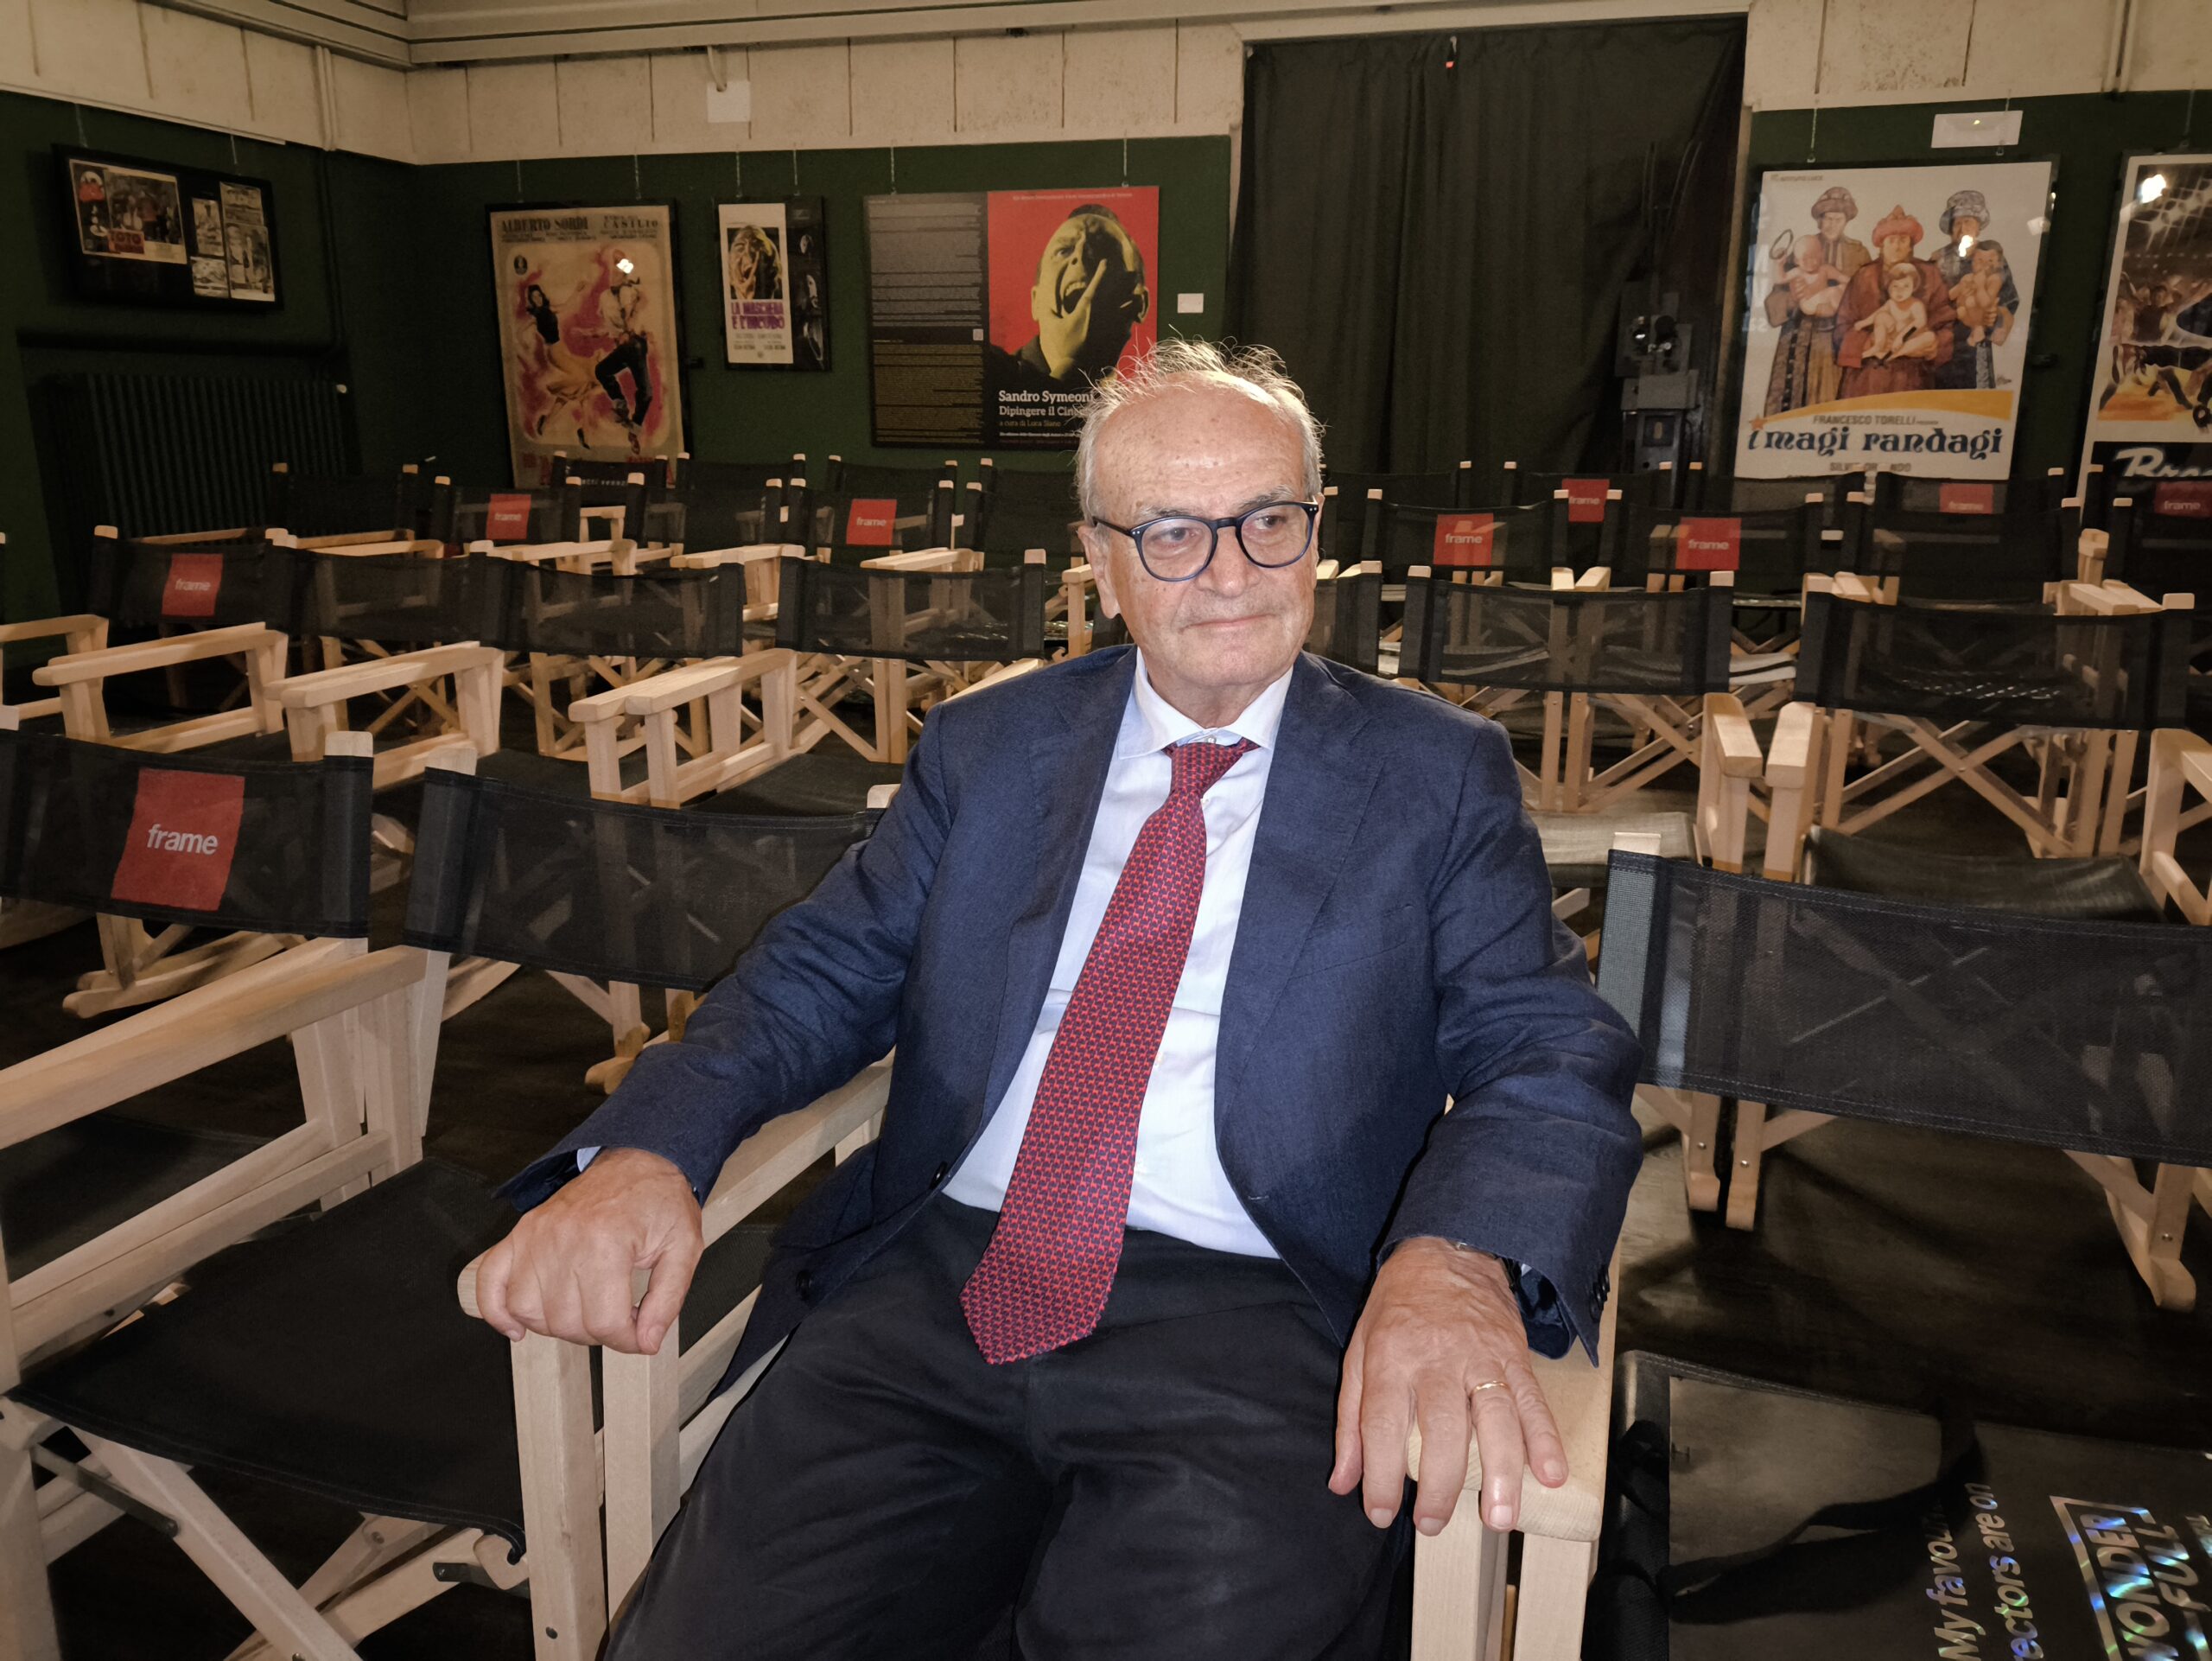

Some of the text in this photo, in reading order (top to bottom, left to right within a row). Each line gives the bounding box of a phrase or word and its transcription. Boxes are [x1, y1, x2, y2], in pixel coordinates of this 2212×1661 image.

[999, 390, 1040, 402] Sandro
[999, 405, 1046, 417] Dipingere
[1048, 406, 1055, 416] il
[1812, 415, 1872, 425] FRANCESCO
[1874, 415, 1916, 425] TORELLI
[1764, 426, 1850, 457] magi
[1862, 428, 2003, 460] randagi
[2164, 500, 2202, 511] frame
[856, 516, 887, 526] frame
[1445, 532, 1483, 544] frame
[1688, 538, 1729, 550] frame
[175, 578, 211, 591] frame
[147, 824, 219, 855] frame
[1964, 1482, 1999, 1511] on
[1975, 1512, 2015, 1553] are
[1934, 1607, 1987, 1661] My
